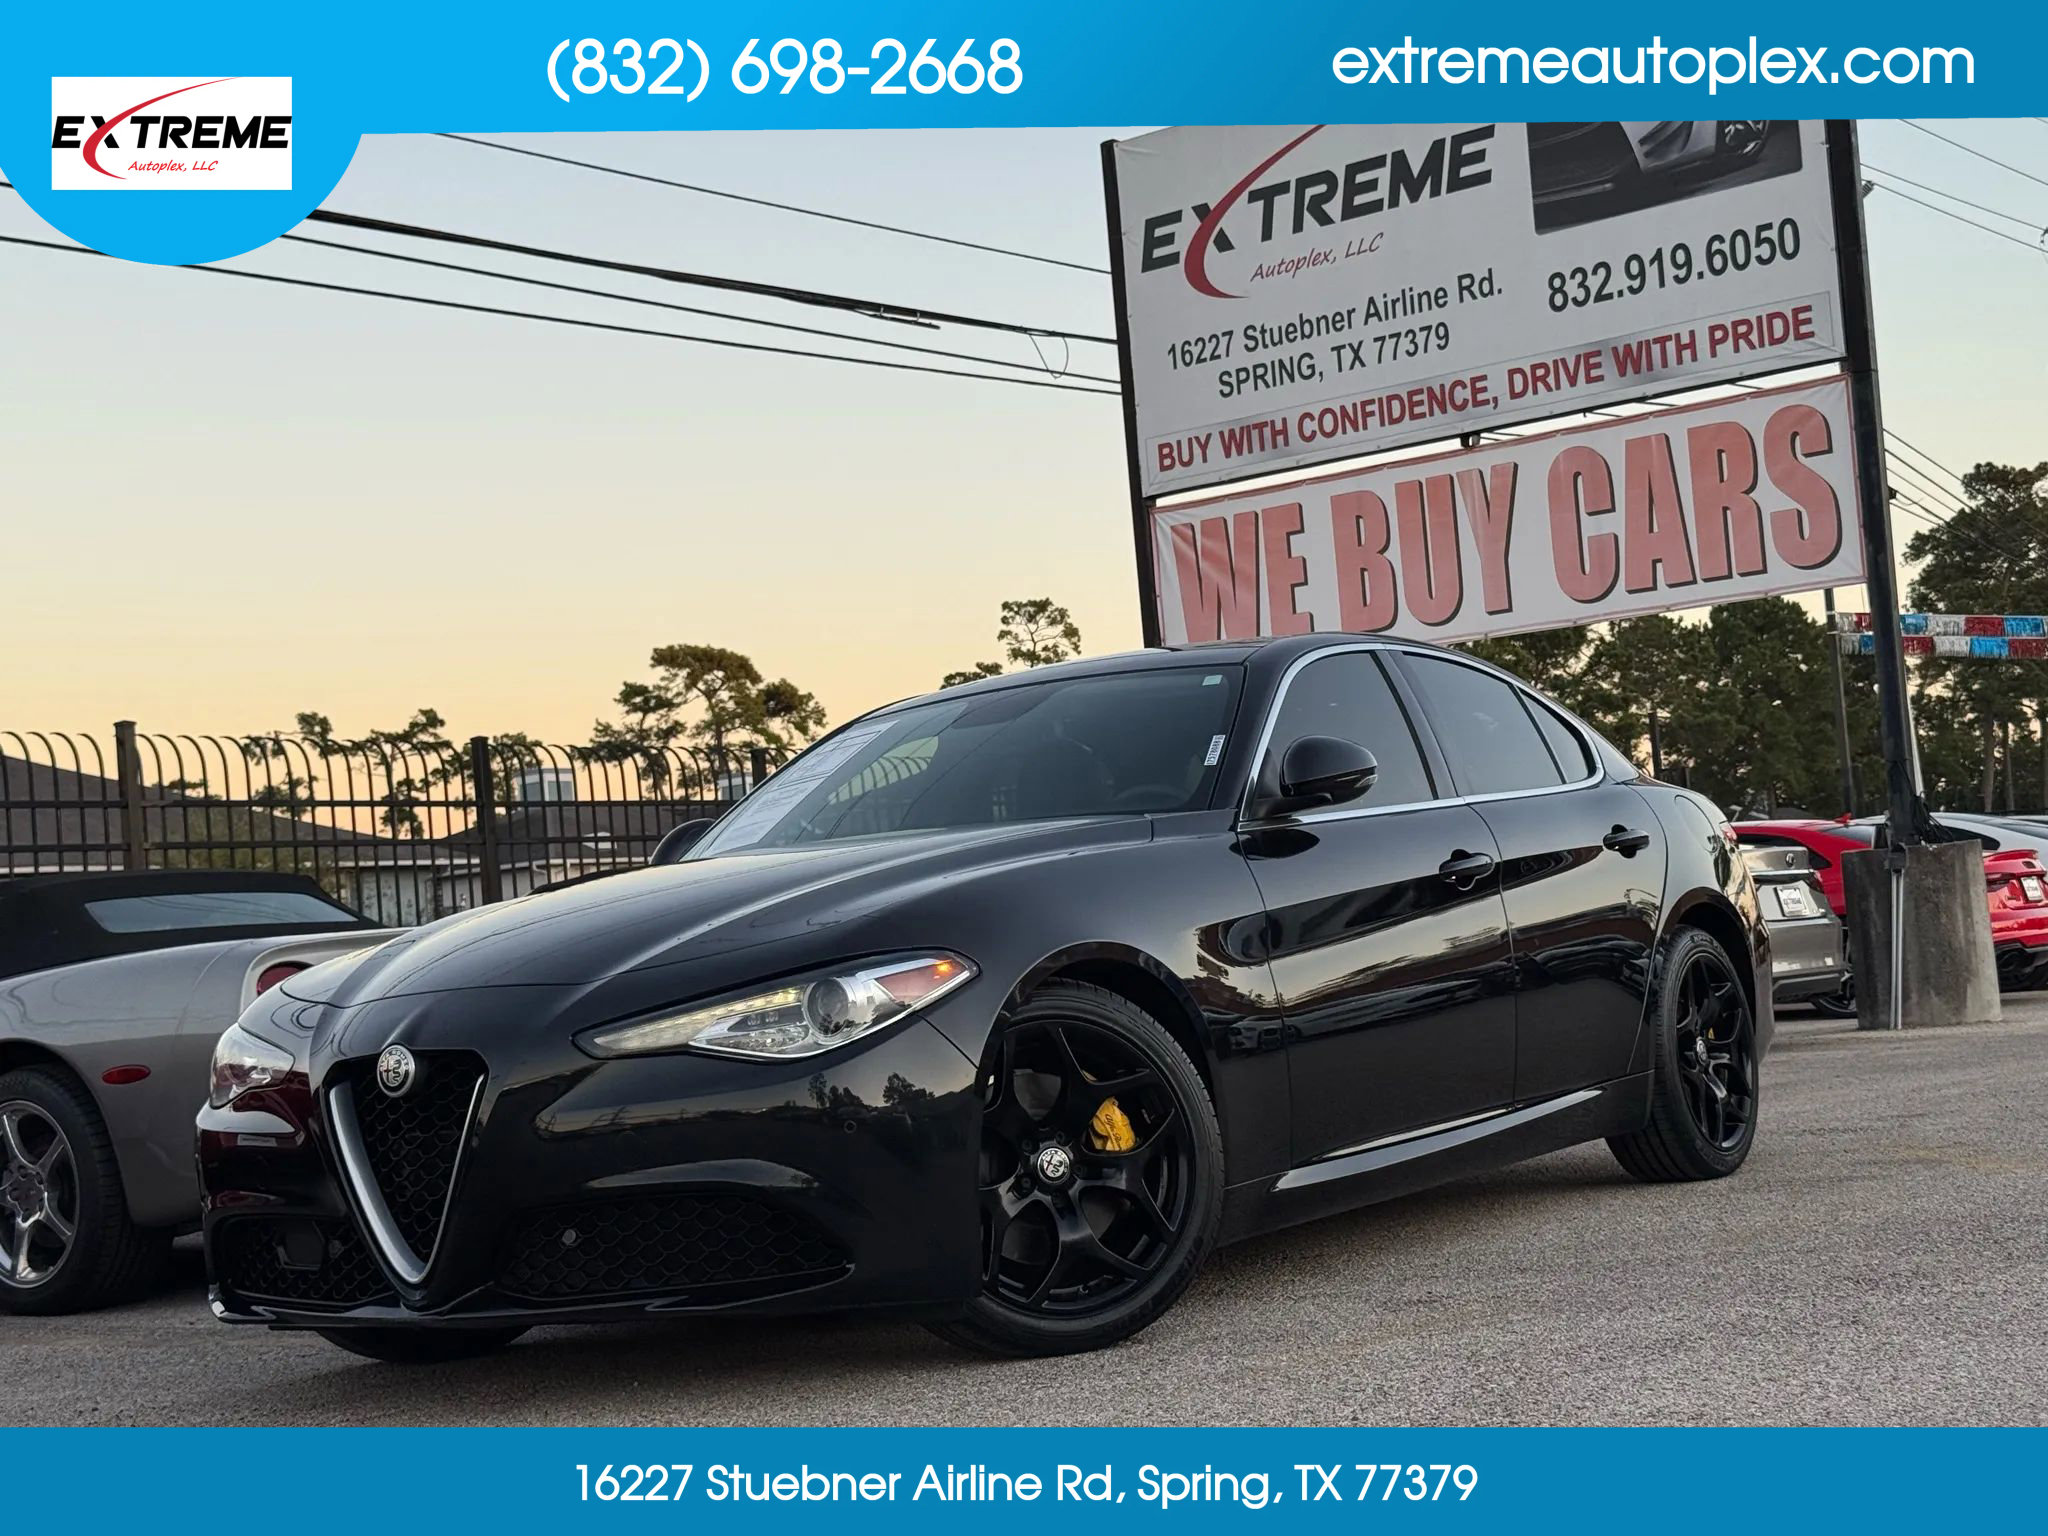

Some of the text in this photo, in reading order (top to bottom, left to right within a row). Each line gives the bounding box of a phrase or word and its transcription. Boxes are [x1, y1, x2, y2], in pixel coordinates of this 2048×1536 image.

[1141, 124, 1495, 273] EXTREME
[1250, 232, 1384, 282] Autoplex, LLC
[1547, 217, 1801, 313] 832.919.6050
[1167, 268, 1502, 370] 16227 Stuebner Airline Rd.
[1218, 321, 1450, 398] SPRING, TX 77379
[1157, 304, 1815, 473] BUY WITH CONFIDENCE, DRIVE WITH PRIDE
[1170, 403, 1844, 643] WE BUY CARS
